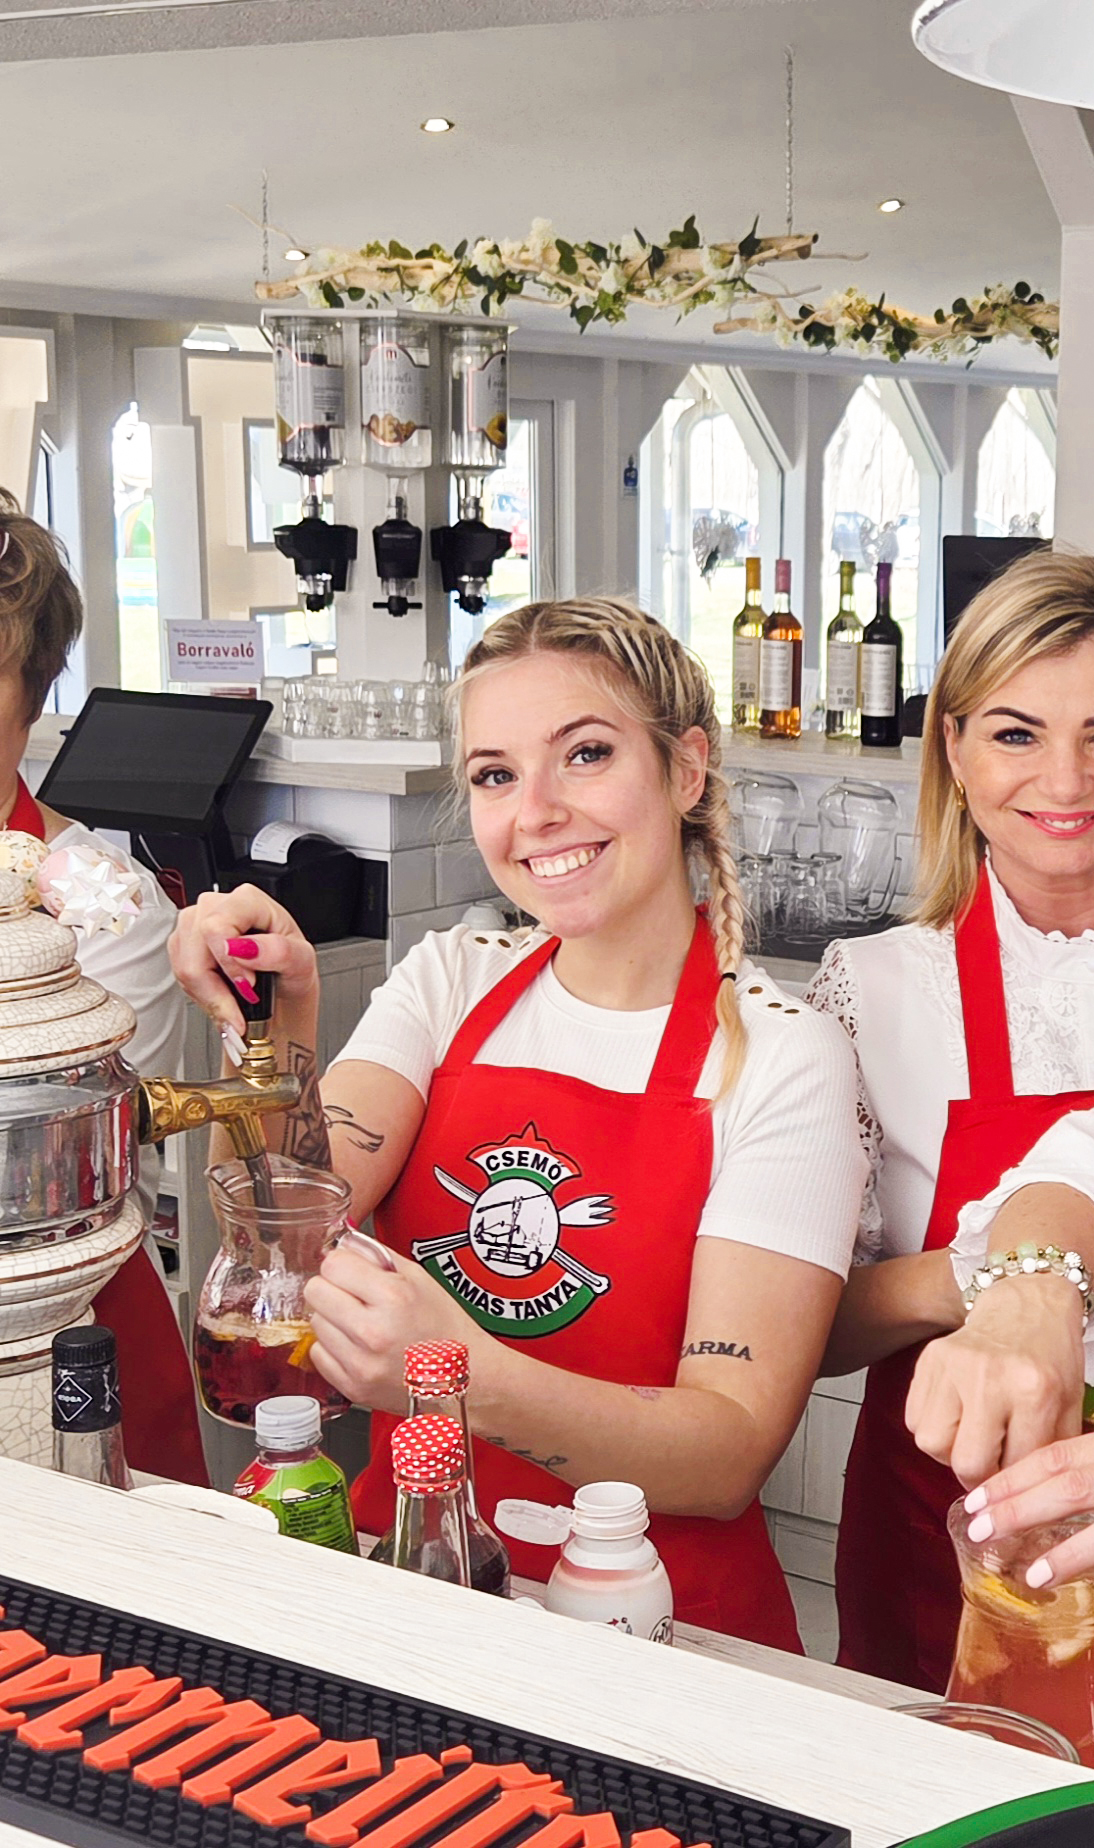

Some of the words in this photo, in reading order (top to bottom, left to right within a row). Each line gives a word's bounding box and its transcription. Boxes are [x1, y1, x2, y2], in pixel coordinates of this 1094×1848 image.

[177, 641, 254, 658] Borravaló
[485, 1150, 565, 1181] CSEMŐ
[509, 1279, 580, 1320] TANYA
[680, 1341, 753, 1361] ARMA
